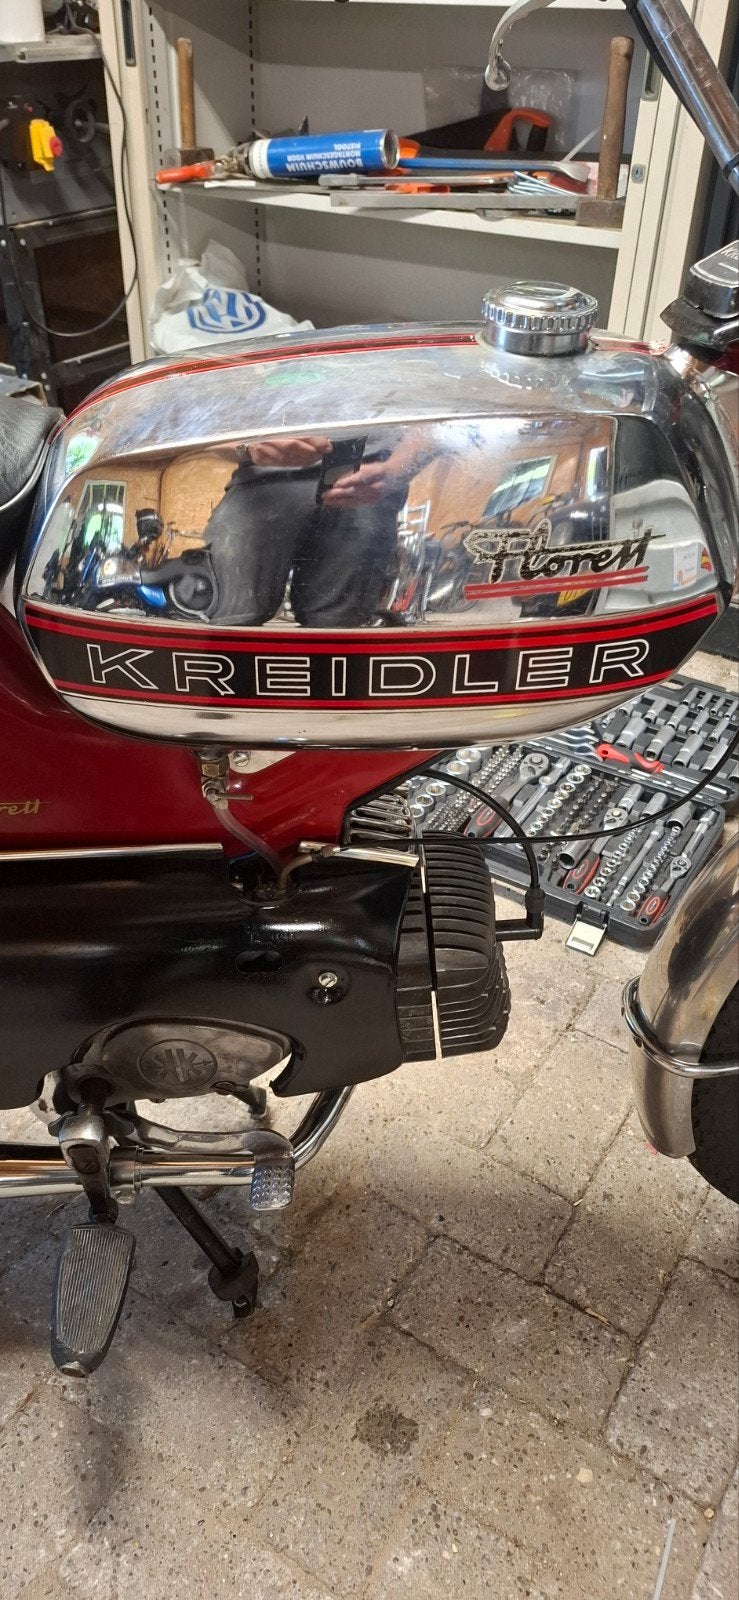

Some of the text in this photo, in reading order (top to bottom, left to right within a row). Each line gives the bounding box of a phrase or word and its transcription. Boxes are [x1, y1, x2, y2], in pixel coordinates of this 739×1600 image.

[285, 158, 364, 172] BOUWSCHUIM
[286, 154, 306, 162] VOOR
[463, 518, 666, 584] Florett
[86, 638, 650, 696] KREIDLER
